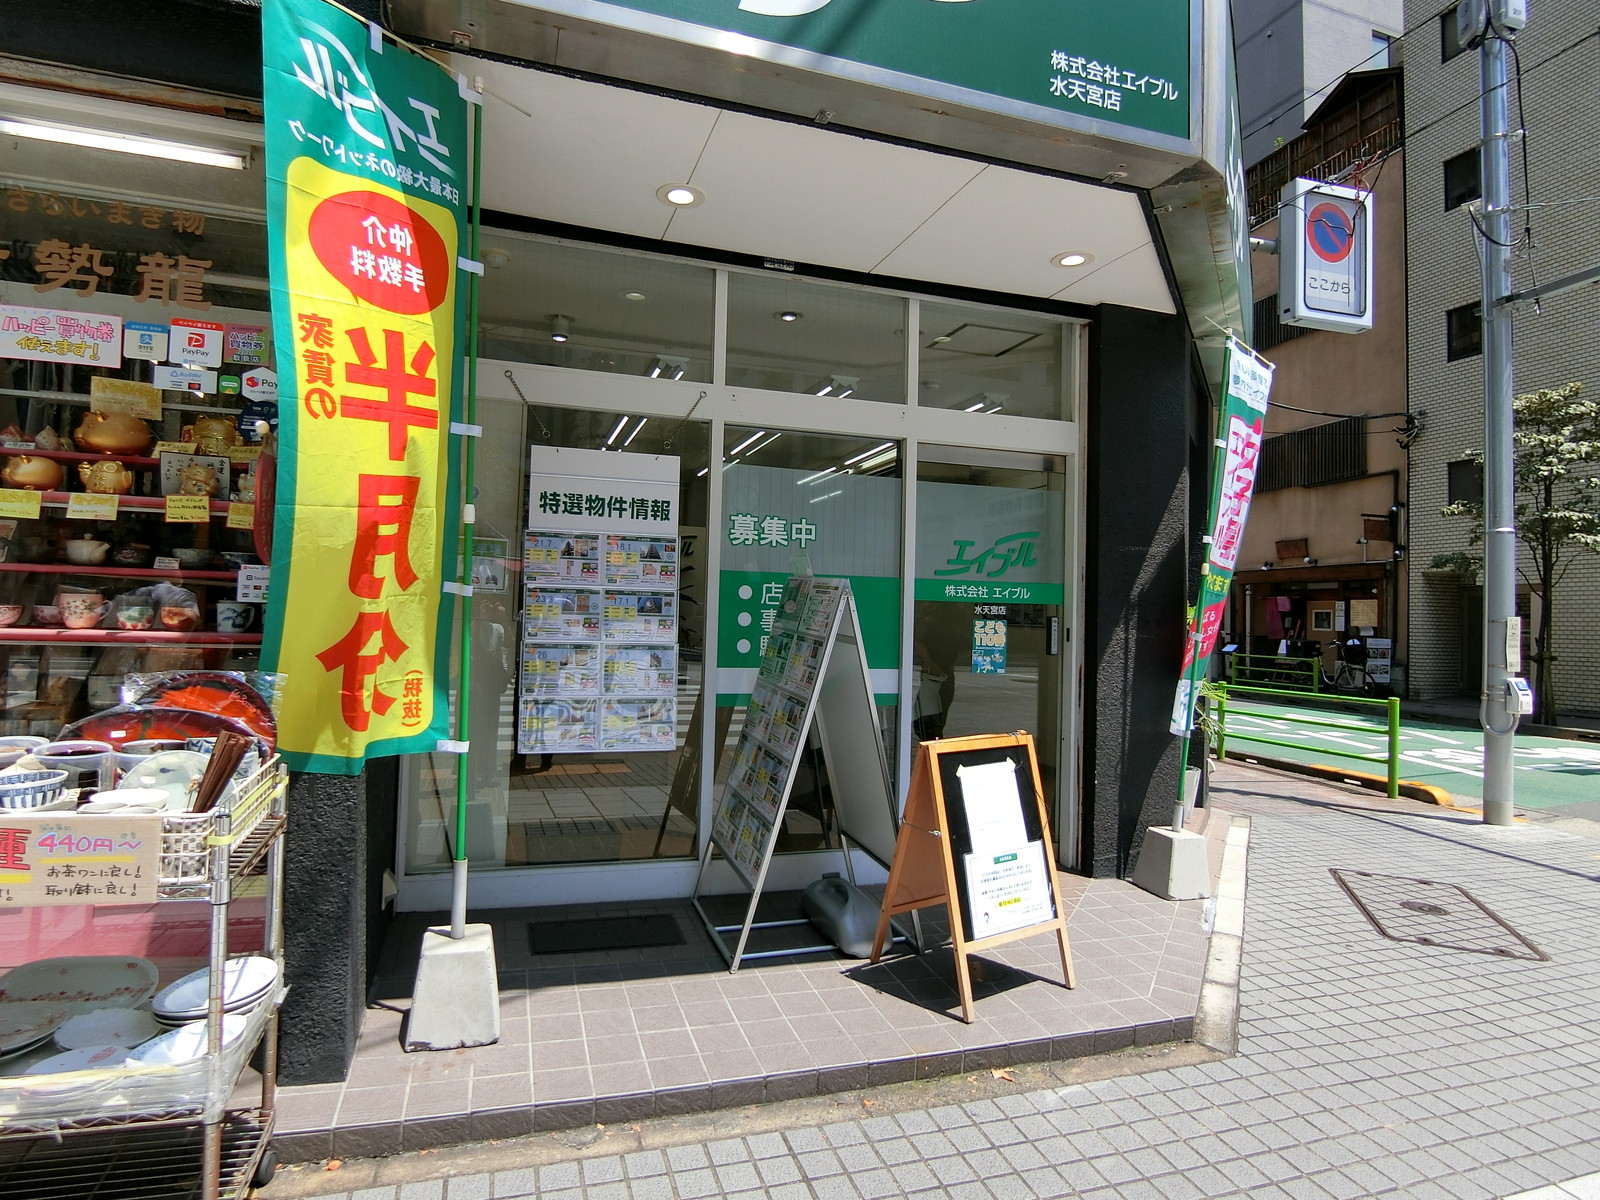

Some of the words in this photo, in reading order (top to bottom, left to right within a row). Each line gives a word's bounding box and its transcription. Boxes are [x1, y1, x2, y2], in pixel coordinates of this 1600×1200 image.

[1050, 49, 1179, 101] 株式会社エイブル
[1049, 75, 1122, 112] 水天宮店
[0, 238, 214, 311] 勢龍
[1308, 276, 1351, 295] ここから
[182, 347, 210, 358] PayPay
[261, 378, 278, 390] Pay
[538, 490, 671, 522] 特選物件情報
[728, 512, 817, 548] 募集中
[934, 531, 1041, 577] エイブル
[944, 584, 988, 598] 株式会社
[992, 587, 1031, 599] エイブル
[974, 605, 1007, 615] 水天宮店
[974, 620, 1007, 634] こども
[974, 633, 1006, 648] 110番
